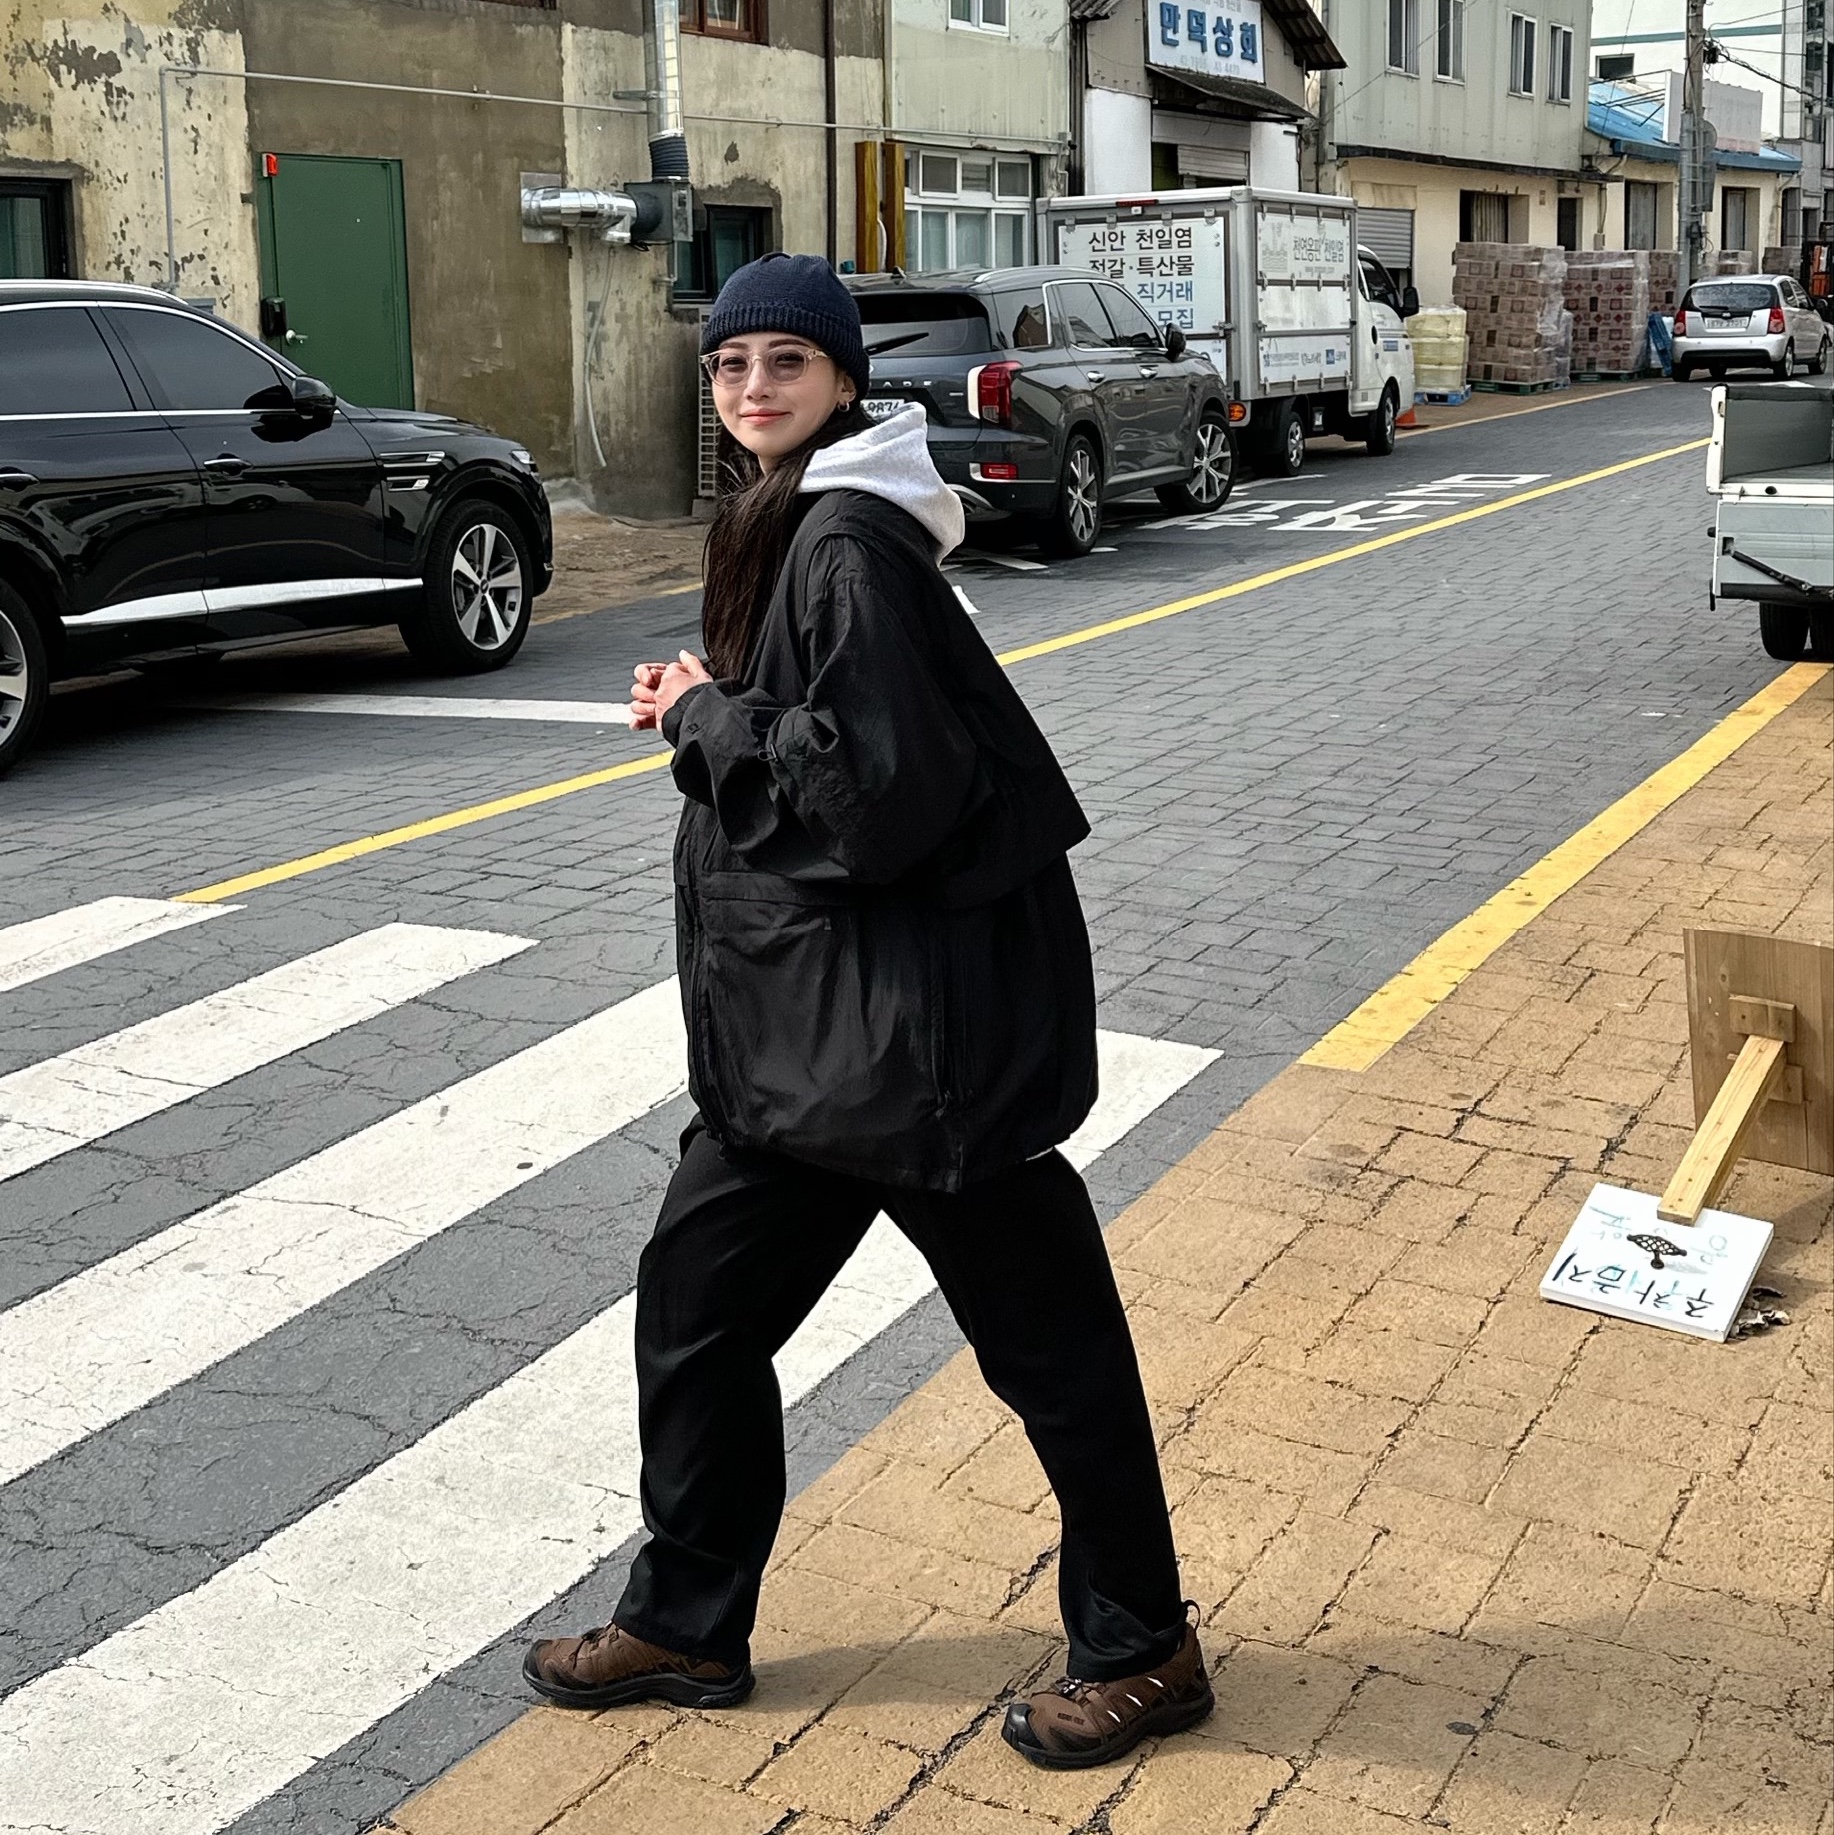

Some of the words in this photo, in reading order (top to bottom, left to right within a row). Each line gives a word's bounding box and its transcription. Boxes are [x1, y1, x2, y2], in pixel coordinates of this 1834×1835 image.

[1160, 2, 1258, 64] 만덕상회
[1088, 230, 1126, 252] 신안
[1135, 226, 1192, 250] 천일염
[1137, 280, 1194, 303] 직거래
[1158, 308, 1194, 329] 모집
[1552, 1252, 1715, 1317] 주차금지
